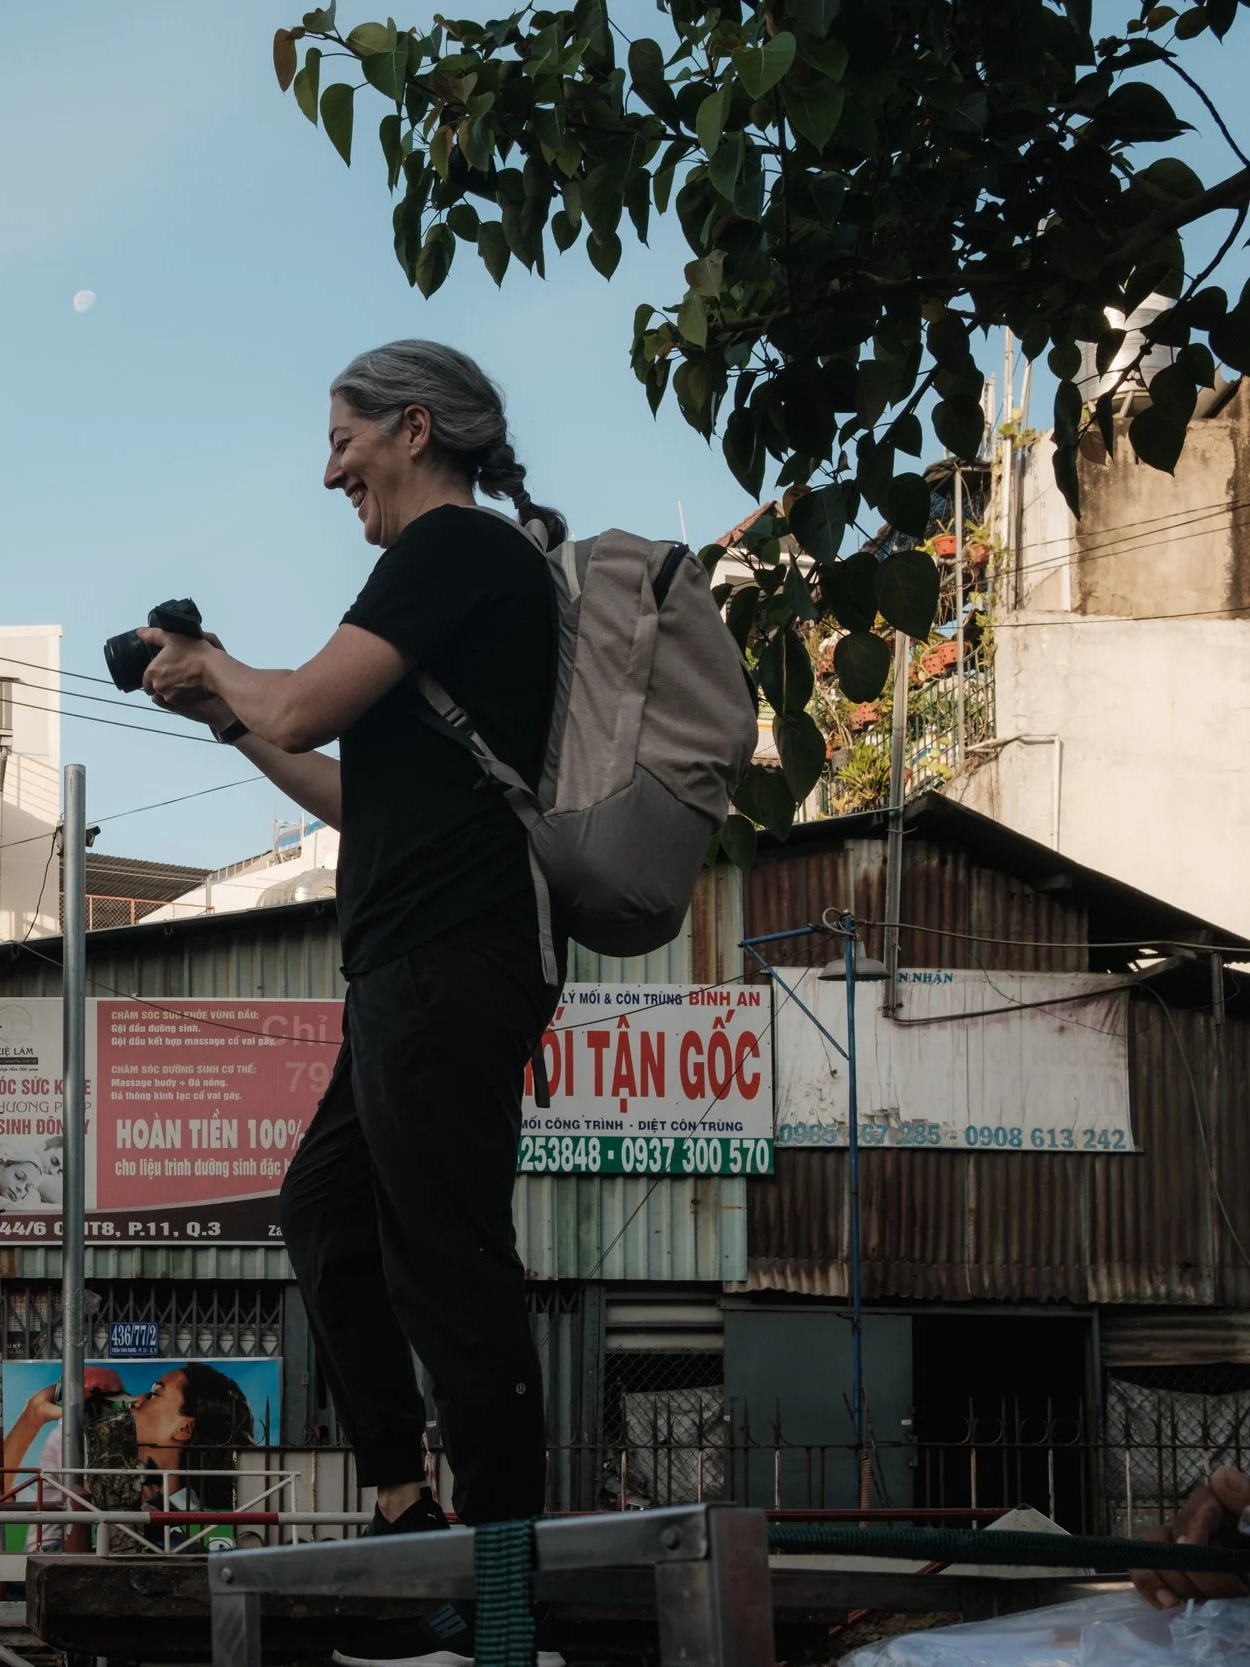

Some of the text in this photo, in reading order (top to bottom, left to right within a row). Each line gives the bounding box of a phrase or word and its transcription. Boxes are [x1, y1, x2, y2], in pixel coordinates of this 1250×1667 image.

[913, 970, 954, 985] NHẬN
[562, 987, 761, 1007] LÝ MỐI & CÔN TRÙNG BÌNH AN
[111, 1009, 139, 1020] CHĂM
[141, 1009, 159, 1020] SÓC
[210, 1009, 235, 1020] VÙNG
[237, 1009, 260, 1020] ĐẦU:
[111, 1023, 201, 1035] Gội đầu dưỡng sinh.
[261, 1014, 328, 1047] Chỉ
[14, 1046, 34, 1056] LÂM
[111, 1037, 126, 1049] Gội
[128, 1036, 146, 1047] đầu
[148, 1036, 163, 1047] kết
[165, 1037, 182, 1049] hợp
[184, 1038, 226, 1049] massage
[243, 1037, 256, 1047] vai
[111, 1063, 139, 1075] CHĂM
[141, 1063, 159, 1075] SÓC
[162, 1063, 195, 1075] DƯỠNG
[197, 1065, 219, 1075] SINH
[222, 1064, 236, 1075] CƠ
[587, 1015, 666, 1113] TẬN
[680, 1010, 761, 1101] GỐC
[21, 1075, 49, 1096] SỨC
[111, 1078, 153, 1090] Massage
[155, 1078, 176, 1090] body
[188, 1078, 201, 1088] Đá
[203, 1078, 228, 1090] nóng.
[111, 1090, 124, 1101] Đá
[126, 1090, 151, 1102] thông
[153, 1091, 174, 1101] kinh
[176, 1091, 191, 1102] lạc
[207, 1091, 220, 1101] vai
[36, 1115, 64, 1135] ĐÔN
[116, 1107, 305, 1150] HOÀN TIỀN 100%
[545, 1117, 580, 1131] CÔNG
[584, 1118, 623, 1131] TRÌNH
[638, 1118, 667, 1133] DIỆT
[670, 1119, 696, 1132] CÔN
[699, 1118, 744, 1132] TRÙNG
[859, 1123, 889, 1144] 67
[897, 1122, 943, 1145] 285
[965, 1126, 1023, 1148] 0908
[1030, 1127, 1074, 1149] 613
[1085, 1129, 1126, 1150] 242
[518, 1137, 770, 1174] 253848 0937 300 570
[115, 1158, 136, 1176] cho
[139, 1157, 161, 1180] liệu
[164, 1156, 191, 1176] trình
[194, 1156, 230, 1178] dưỡng
[232, 1157, 258, 1176] sinh
[260, 1156, 281, 1180] đặc
[0, 1221, 48, 1236] 44/6
[53, 1221, 121, 1239] CT8,
[128, 1221, 179, 1238] P.11,
[186, 1221, 222, 1238] Q.3
[111, 1325, 156, 1346] 436/77/2
